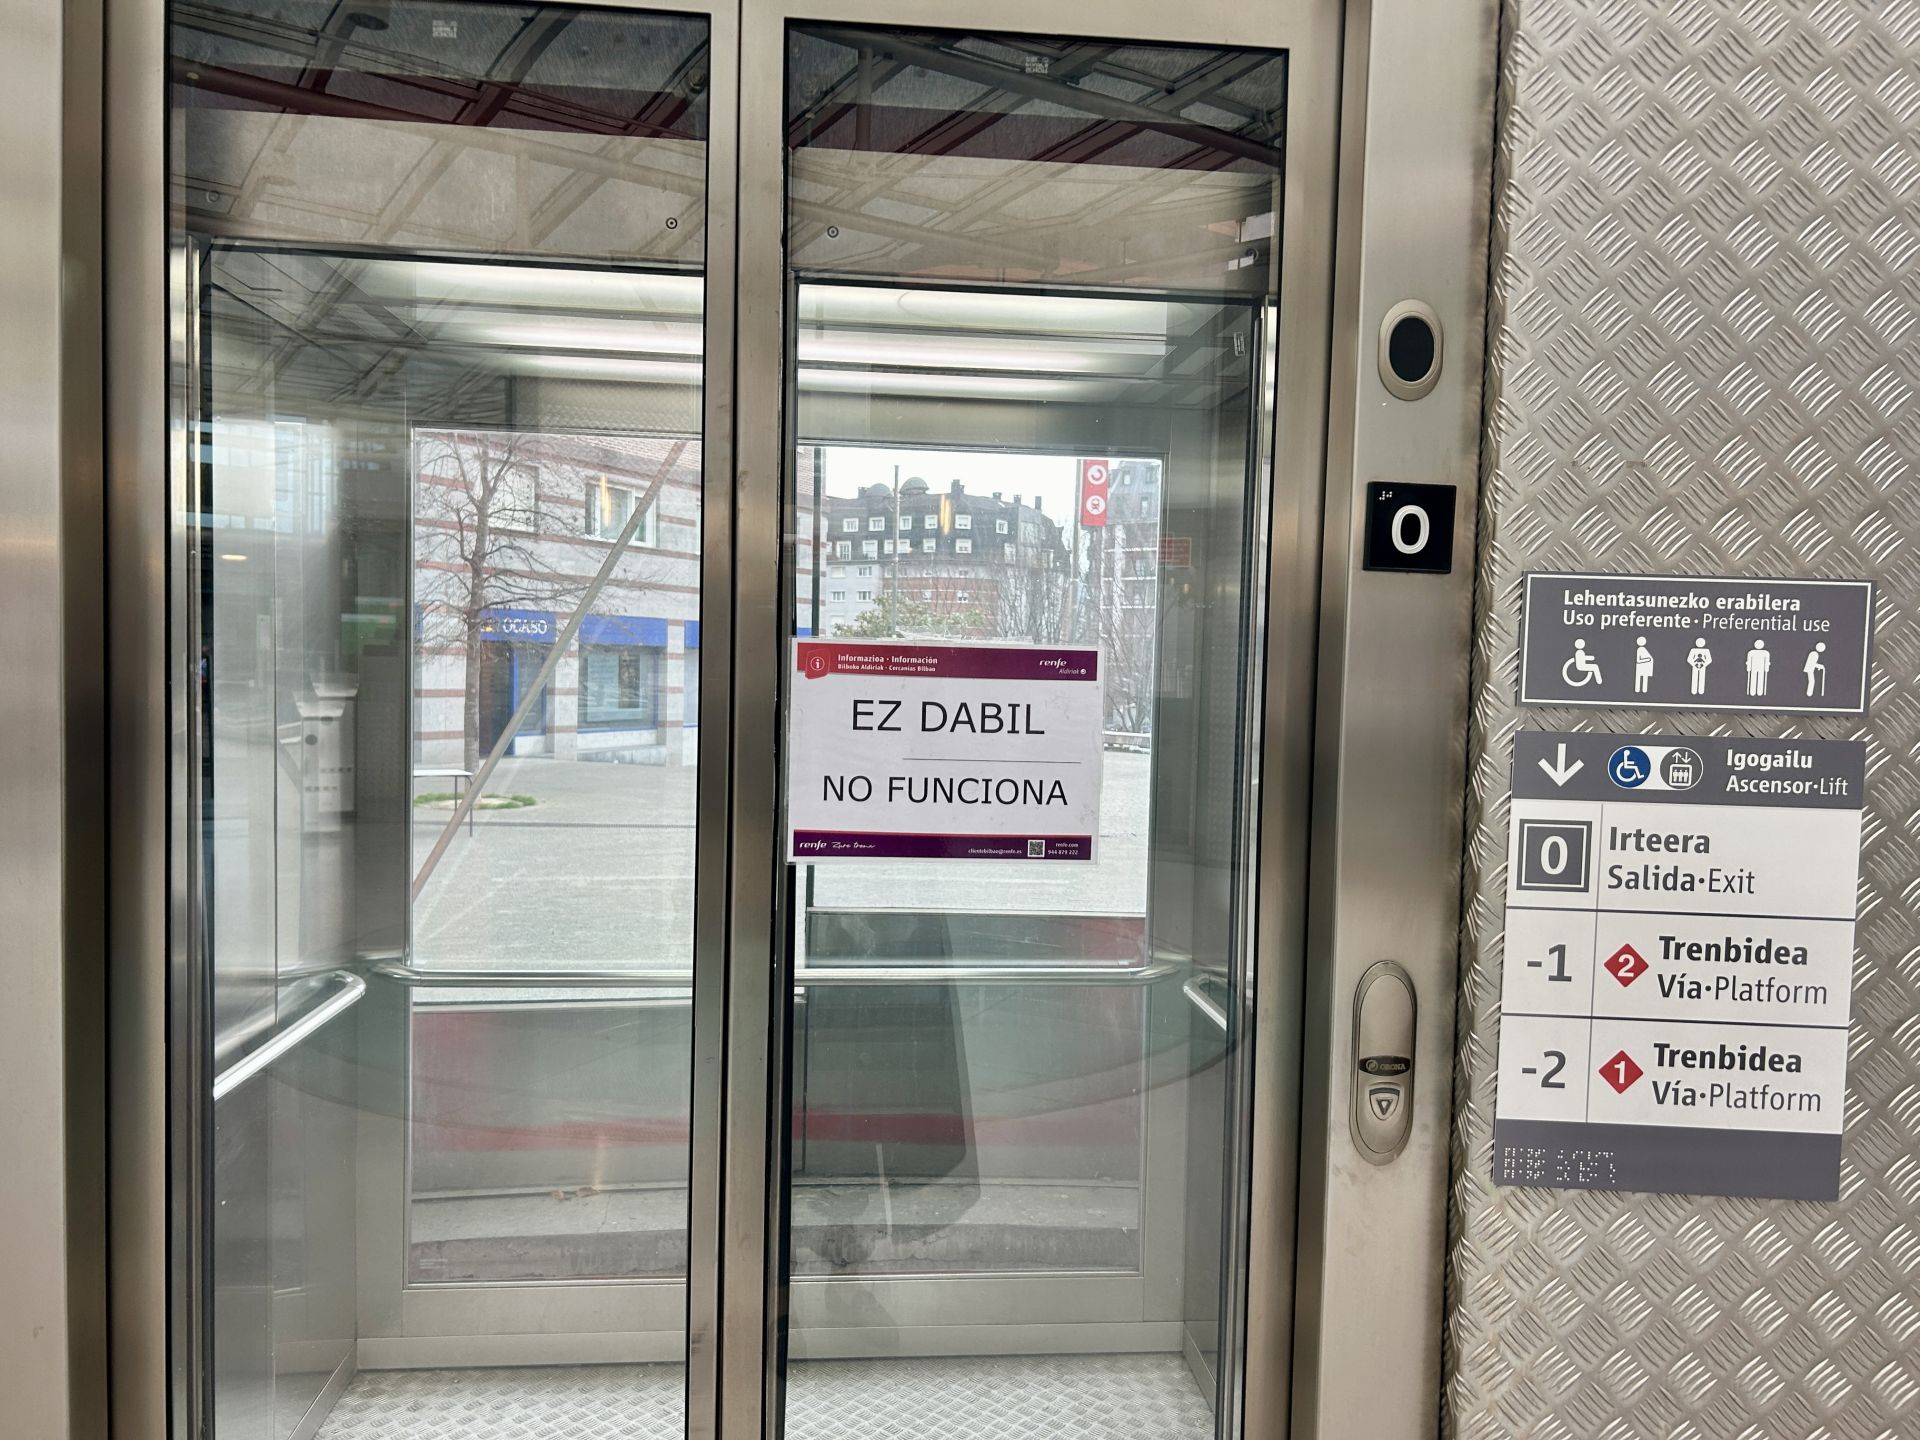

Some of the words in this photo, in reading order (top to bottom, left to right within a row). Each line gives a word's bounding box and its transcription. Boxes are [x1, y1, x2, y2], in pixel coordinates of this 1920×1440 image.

[1391, 504, 1430, 555] 0
[1563, 589, 1710, 609] Lehentasunezko
[1716, 593, 1801, 612] erabilera
[503, 616, 548, 635] OCASO
[1562, 609, 1595, 626] Uso
[1803, 618, 1830, 632] use
[837, 653, 885, 663] Informazioa
[891, 655, 938, 664] Información
[860, 663, 884, 671] Aldiriak
[1039, 658, 1067, 669] renfe
[852, 699, 902, 732] EZ
[921, 701, 1045, 735] DABIL
[1726, 748, 1813, 772] Igogailu
[823, 775, 873, 802] NO
[888, 776, 1068, 806] FUNCIONA
[799, 839, 827, 850] renfe
[1609, 826, 1711, 854] Irteera
[1540, 835, 1568, 875] 0
[1526, 943, 1572, 982] -1
[1658, 935, 1808, 966] Trenbidea
[1617, 953, 1636, 978] 2
[1521, 1050, 1567, 1089] -2
[1653, 1042, 1803, 1073] Trenbidea
[1613, 1060, 1626, 1084] 1
